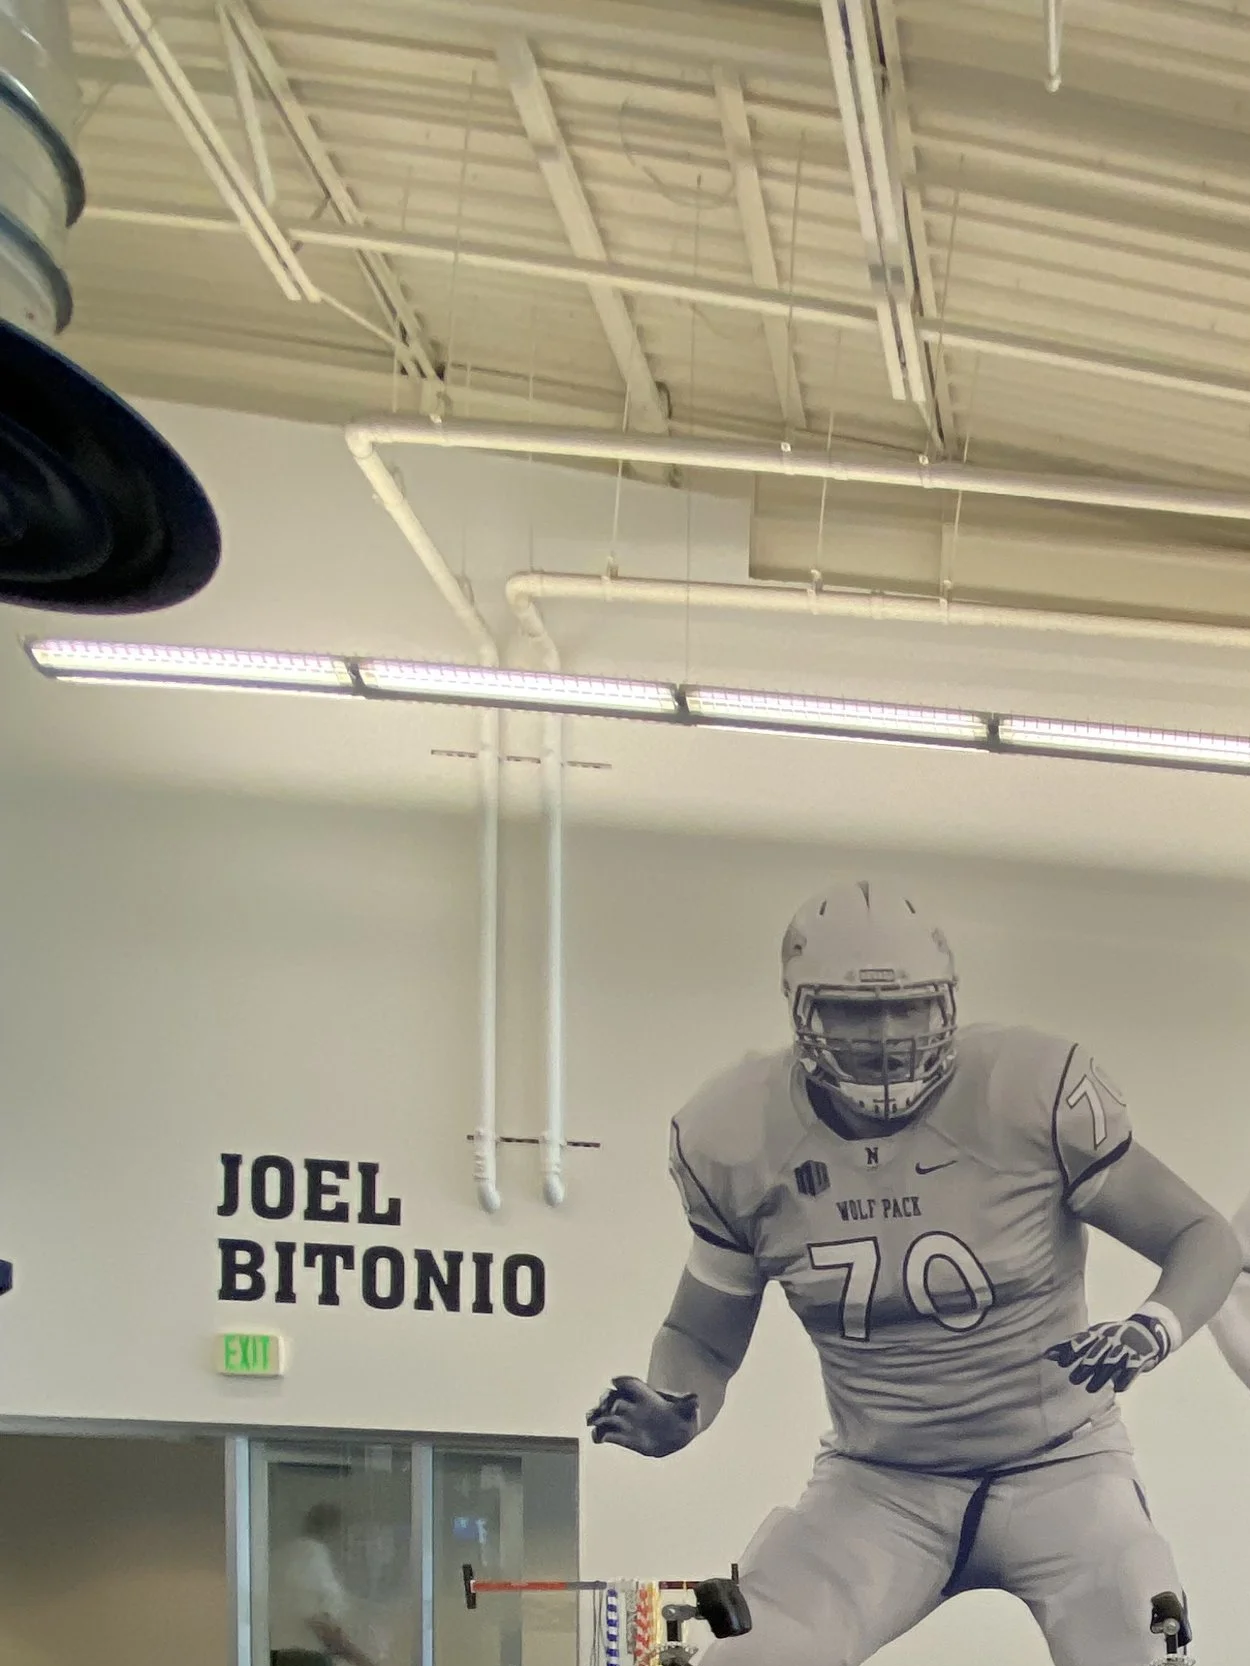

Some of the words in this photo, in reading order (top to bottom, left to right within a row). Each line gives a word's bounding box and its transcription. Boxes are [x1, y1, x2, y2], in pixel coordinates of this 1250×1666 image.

[217, 1153, 402, 1226] JOEL
[836, 1199, 877, 1221] WOLF
[881, 1196, 922, 1219] PACK
[217, 1238, 546, 1318] BITONIO
[807, 1231, 996, 1343] 70
[224, 1334, 270, 1371] EXIT
